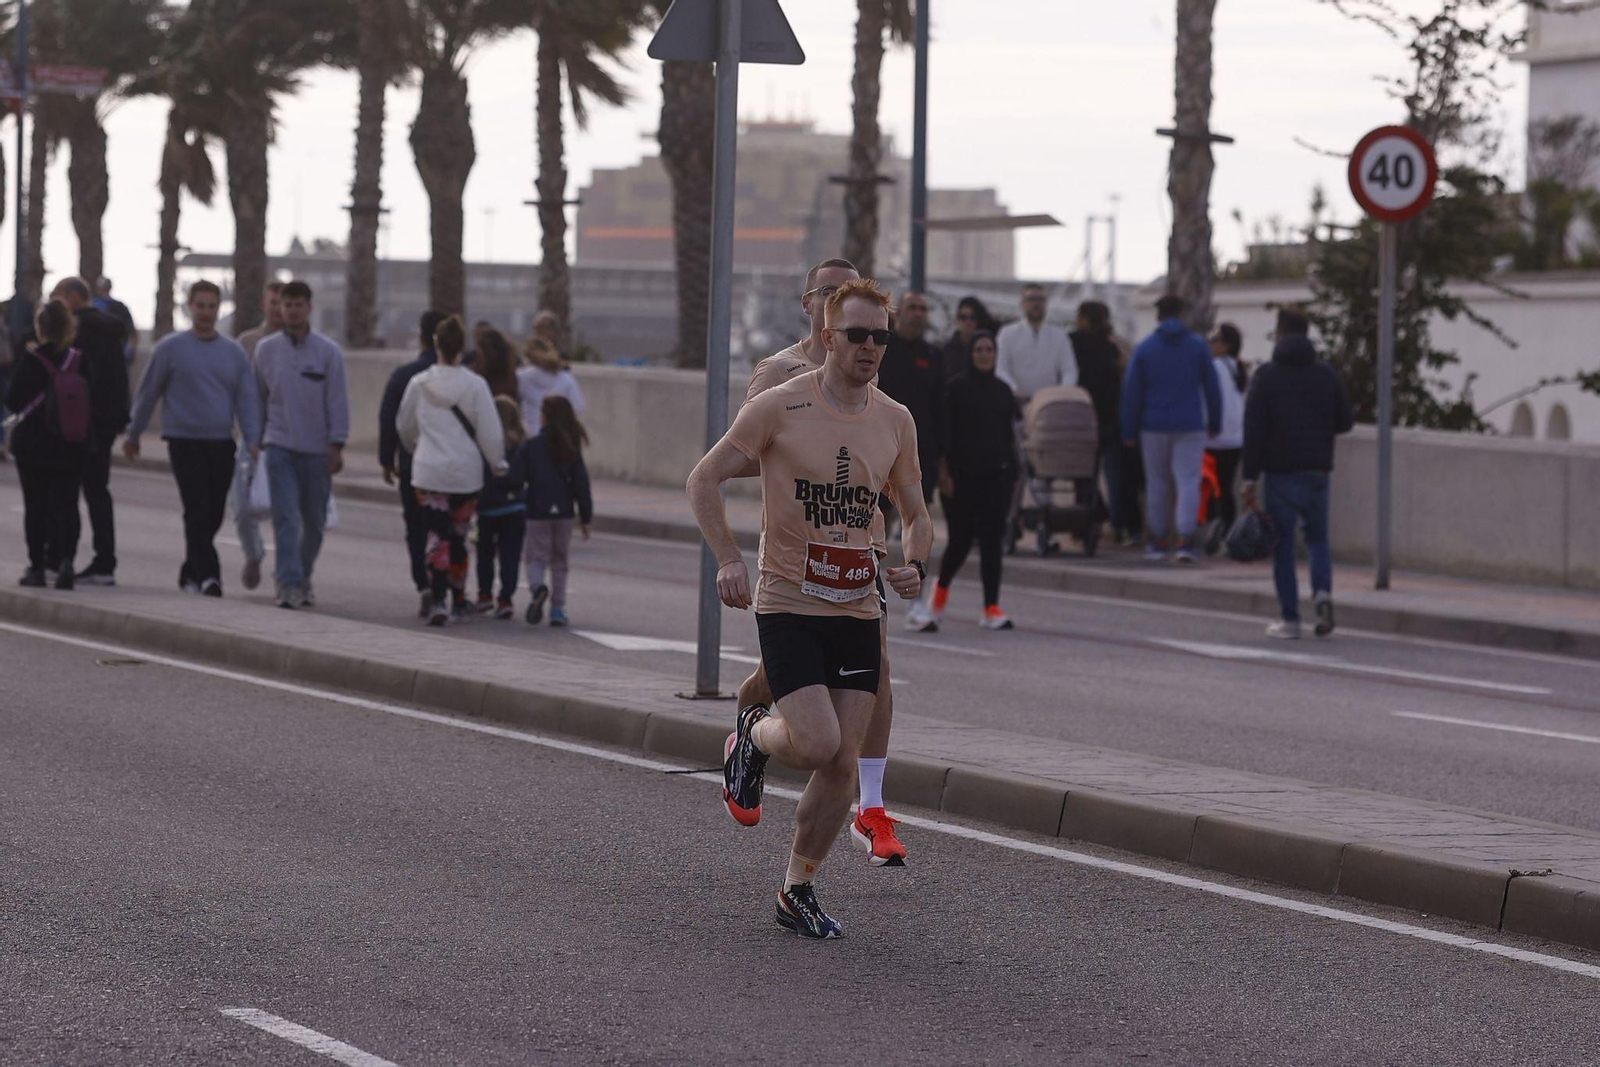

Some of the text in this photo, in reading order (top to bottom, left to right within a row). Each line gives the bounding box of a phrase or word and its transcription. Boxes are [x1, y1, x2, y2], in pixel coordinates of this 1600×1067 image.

[1367, 153, 1414, 190] 40
[803, 501, 848, 529] RUN
[809, 558, 840, 573] BRUNCH
[845, 567, 870, 580] 486
